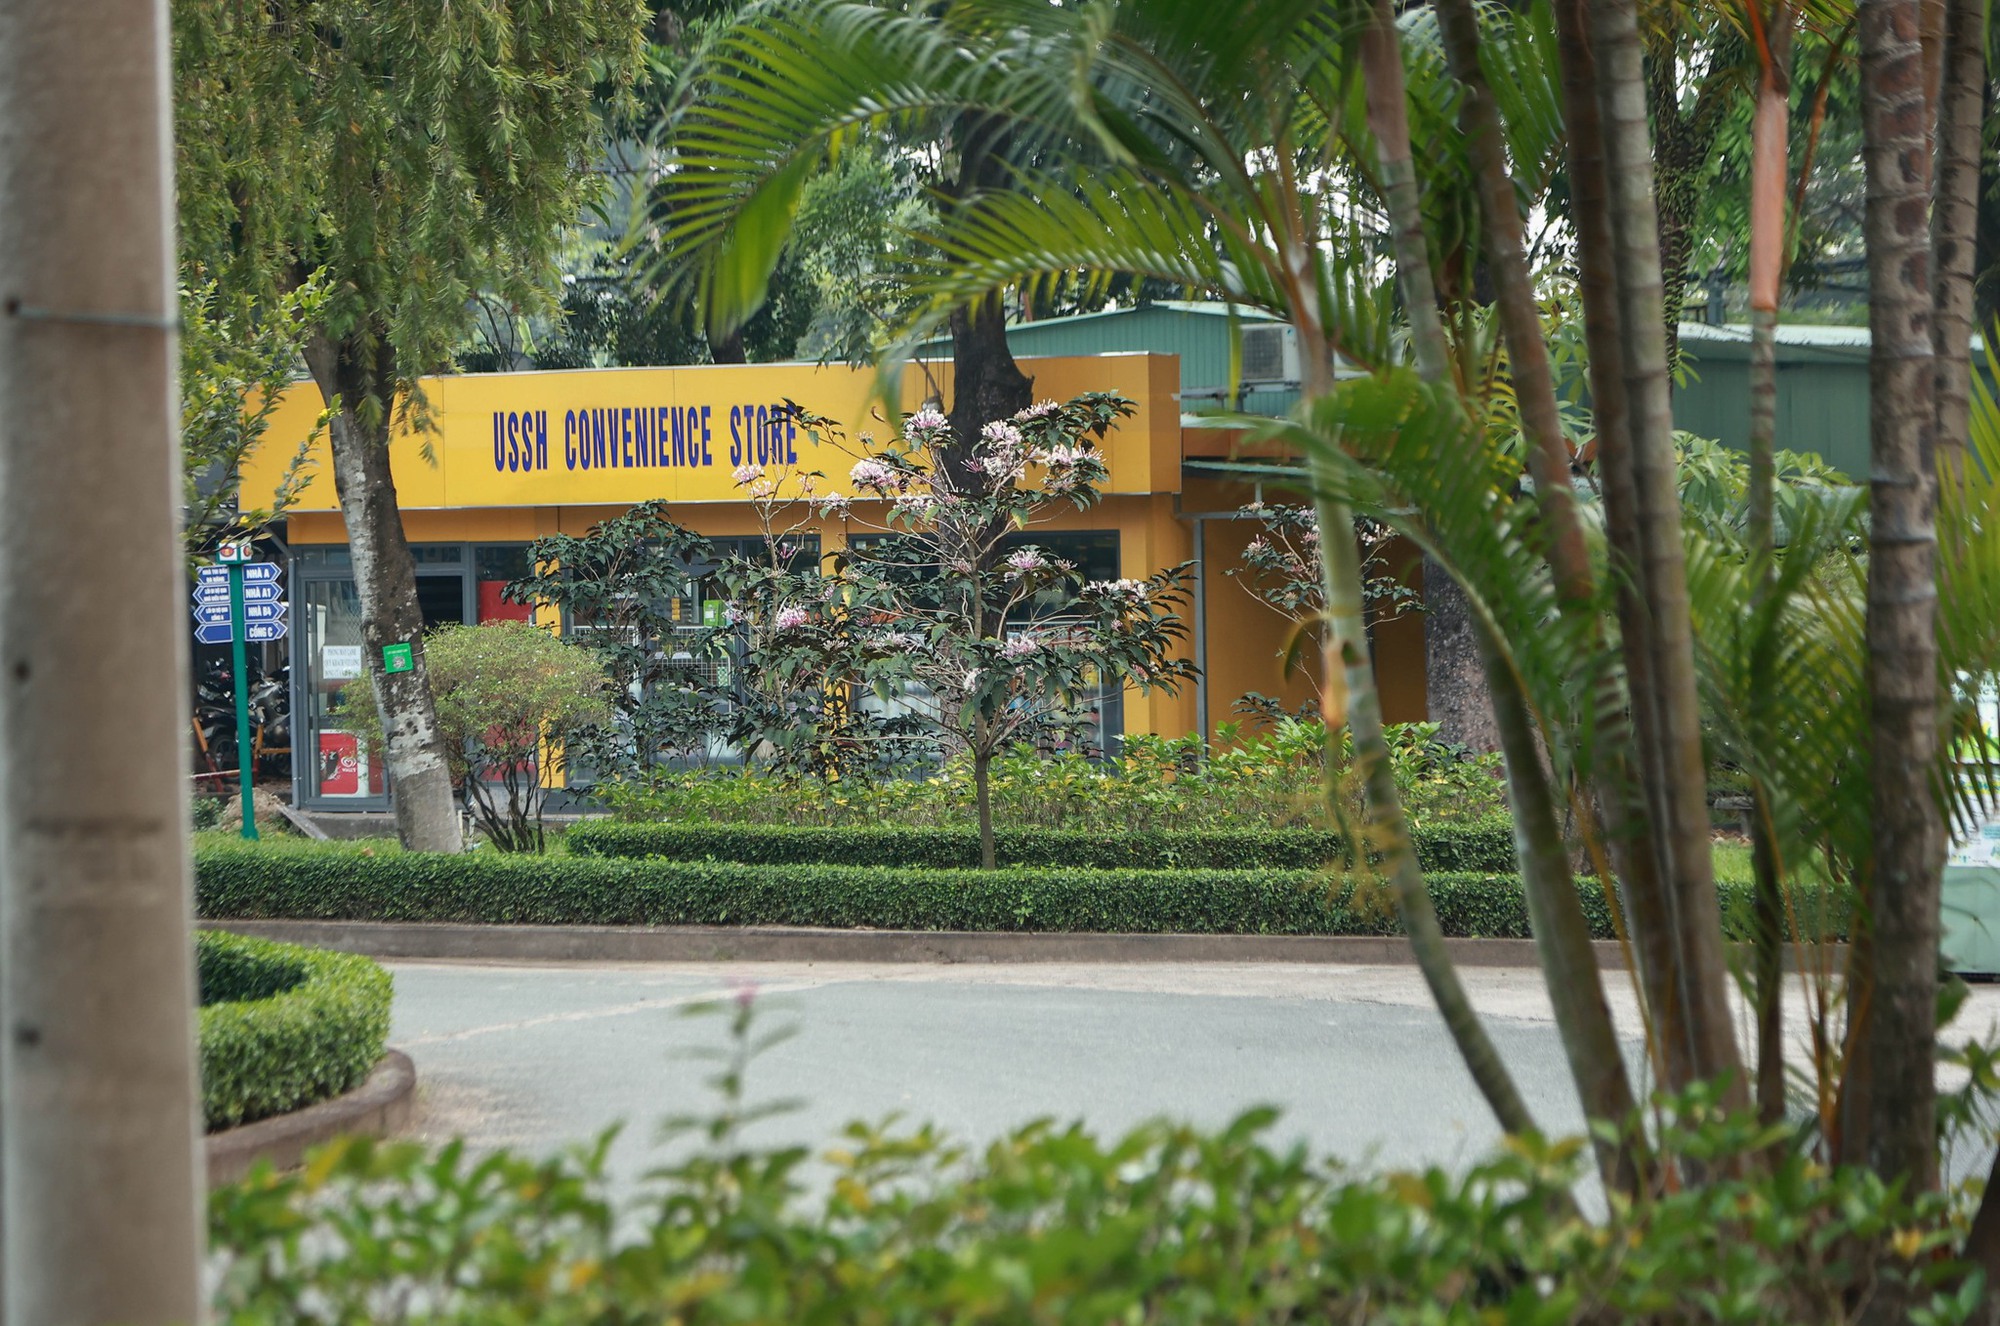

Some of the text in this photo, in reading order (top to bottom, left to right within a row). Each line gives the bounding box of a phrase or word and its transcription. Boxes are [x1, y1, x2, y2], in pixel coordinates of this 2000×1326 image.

[493, 404, 798, 472] USSH CONVENIENCE STORE
[246, 567, 270, 579] NHÀ A
[245, 586, 261, 598] NHÀ
[248, 605, 262, 617] NHÀ
[267, 626, 273, 637] C
